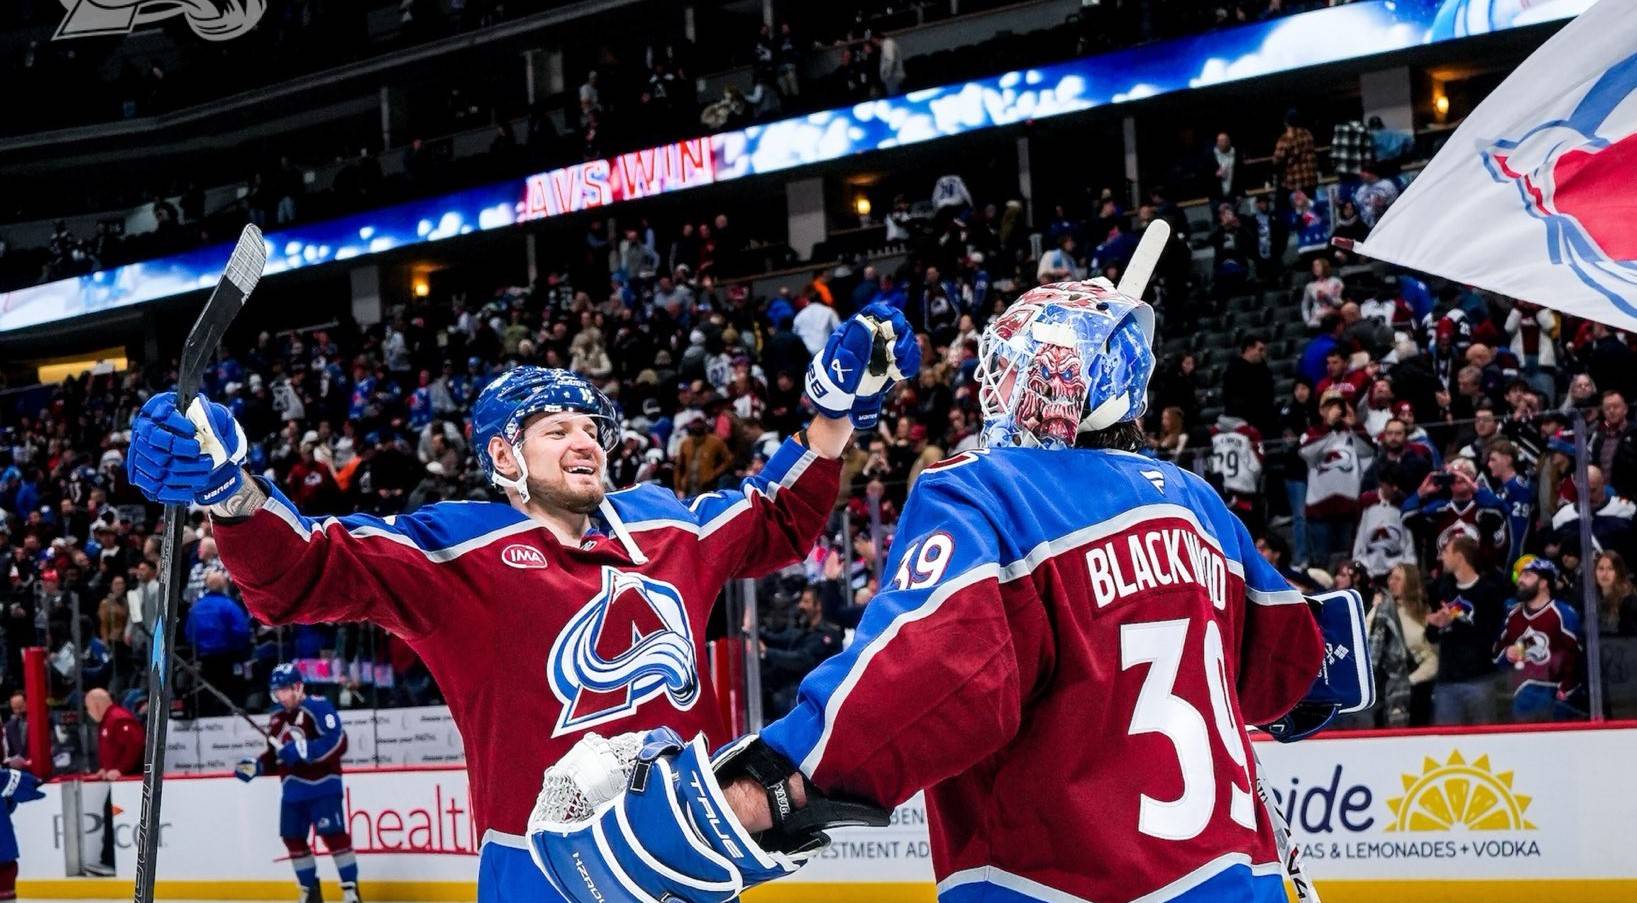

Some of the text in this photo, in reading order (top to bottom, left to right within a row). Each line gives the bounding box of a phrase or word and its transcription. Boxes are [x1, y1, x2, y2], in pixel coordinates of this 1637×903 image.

[526, 136, 714, 218] AVS WIN
[510, 549, 545, 564] IMA
[1086, 528, 1226, 611] BLACKWOD
[324, 713, 336, 729] 8
[690, 770, 745, 858] TRUE
[1271, 764, 1375, 833] ide
[812, 841, 900, 859] ESTMENT
[1294, 841, 1325, 858] AS
[1330, 842, 1341, 858] &
[1346, 841, 1457, 859] LEMONADES
[1472, 840, 1541, 857] VODKA
